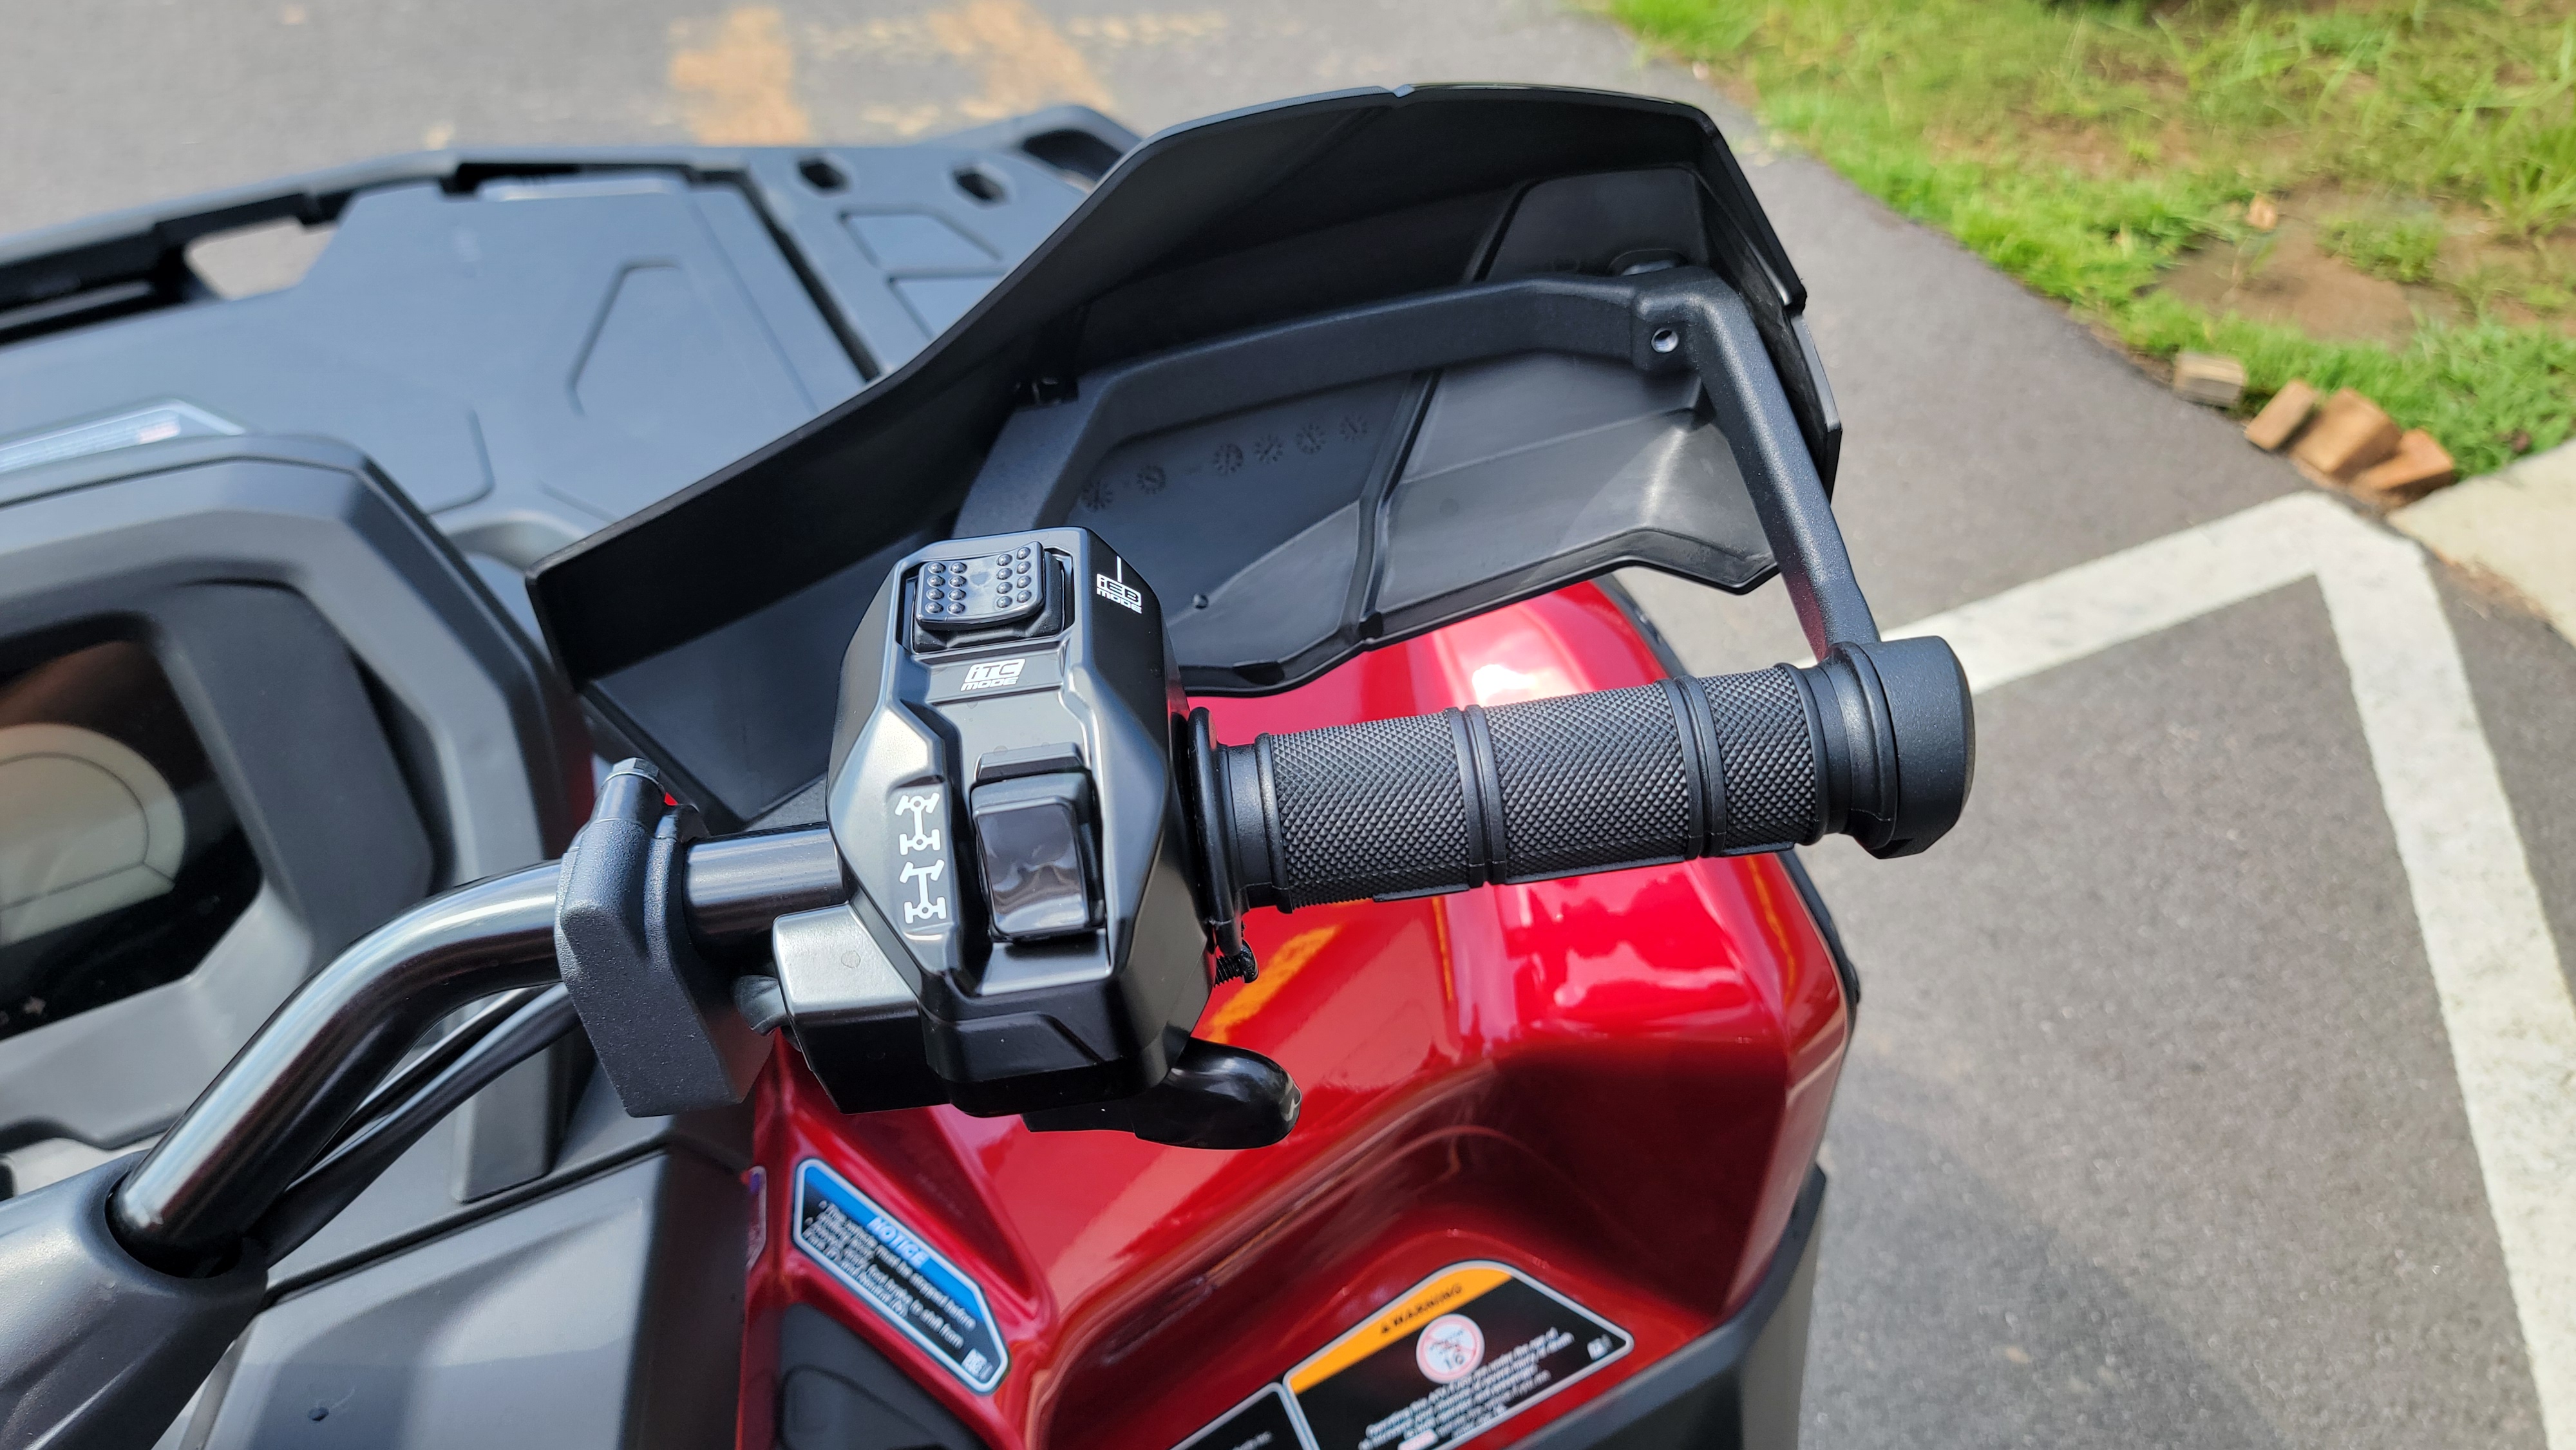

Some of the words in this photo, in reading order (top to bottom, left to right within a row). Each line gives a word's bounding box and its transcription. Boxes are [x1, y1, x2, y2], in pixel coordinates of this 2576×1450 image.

[967, 660, 1023, 682] iTC
[866, 1216, 930, 1268] NOTICE
[875, 1245, 902, 1269] must
[896, 1261, 913, 1279] be
[909, 1272, 949, 1308] stopped
[943, 1299, 976, 1331] before
[884, 1278, 913, 1306] brake
[909, 1299, 923, 1316] to
[920, 1309, 944, 1332] shift
[939, 1323, 964, 1349] from
[1392, 1283, 1463, 1327] WARNING
